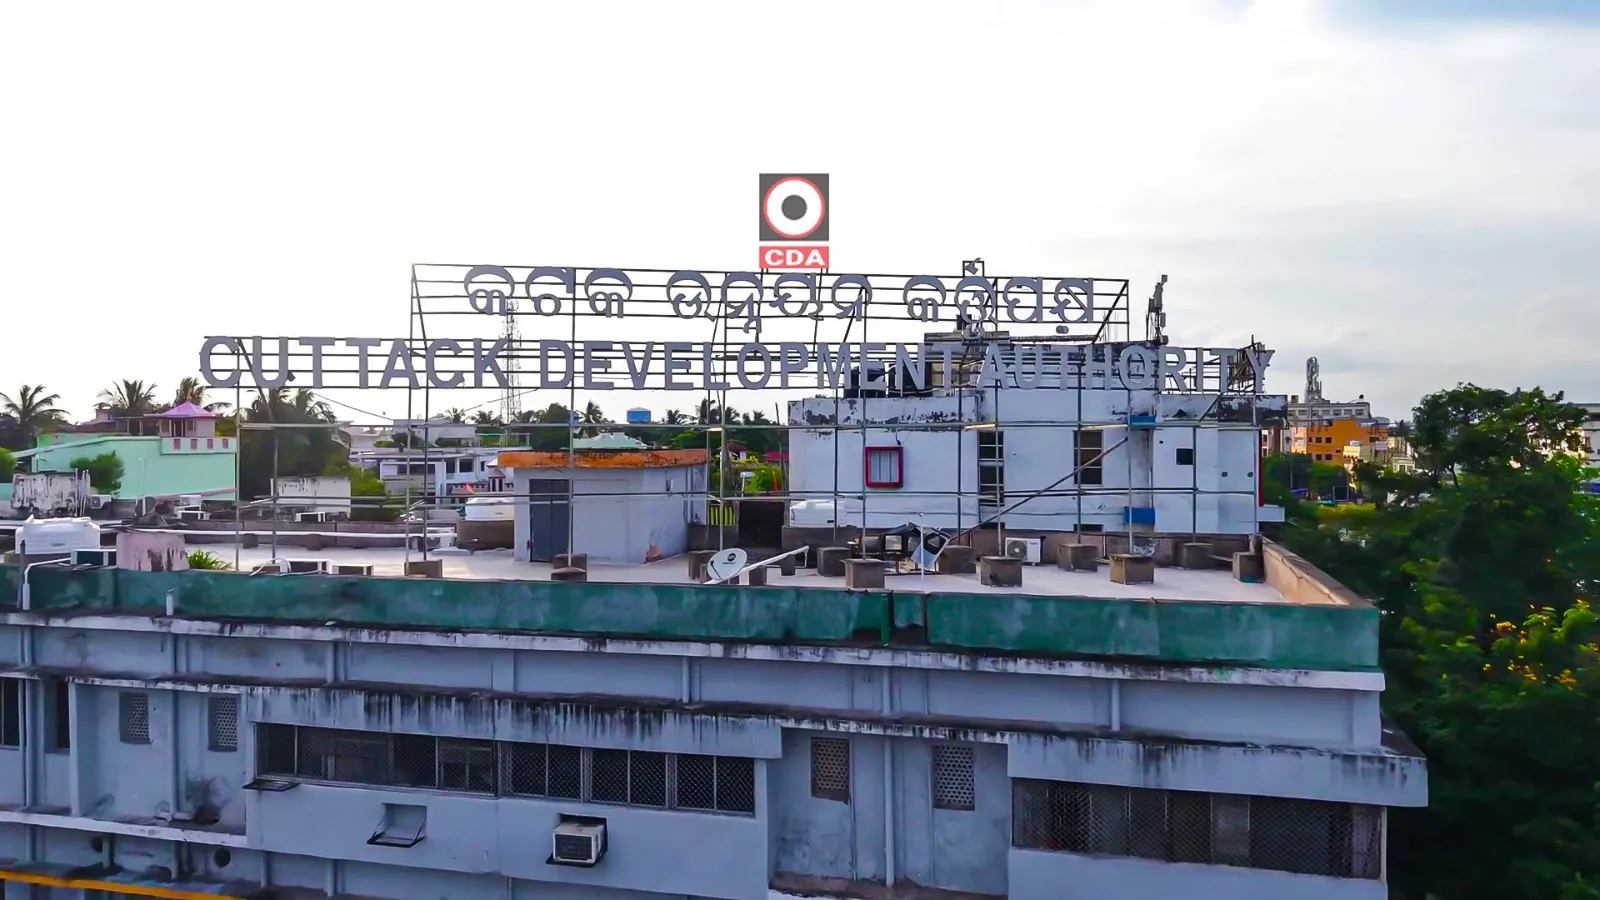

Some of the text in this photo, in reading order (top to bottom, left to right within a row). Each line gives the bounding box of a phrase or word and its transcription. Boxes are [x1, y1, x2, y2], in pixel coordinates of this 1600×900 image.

[764, 248, 826, 267] CDA
[464, 265, 633, 318] କଟକ
[666, 270, 873, 334] ଉନ୍ନୟନ
[200, 335, 1276, 393] CUTTACK DEVELOPMENT AUTHORITY
